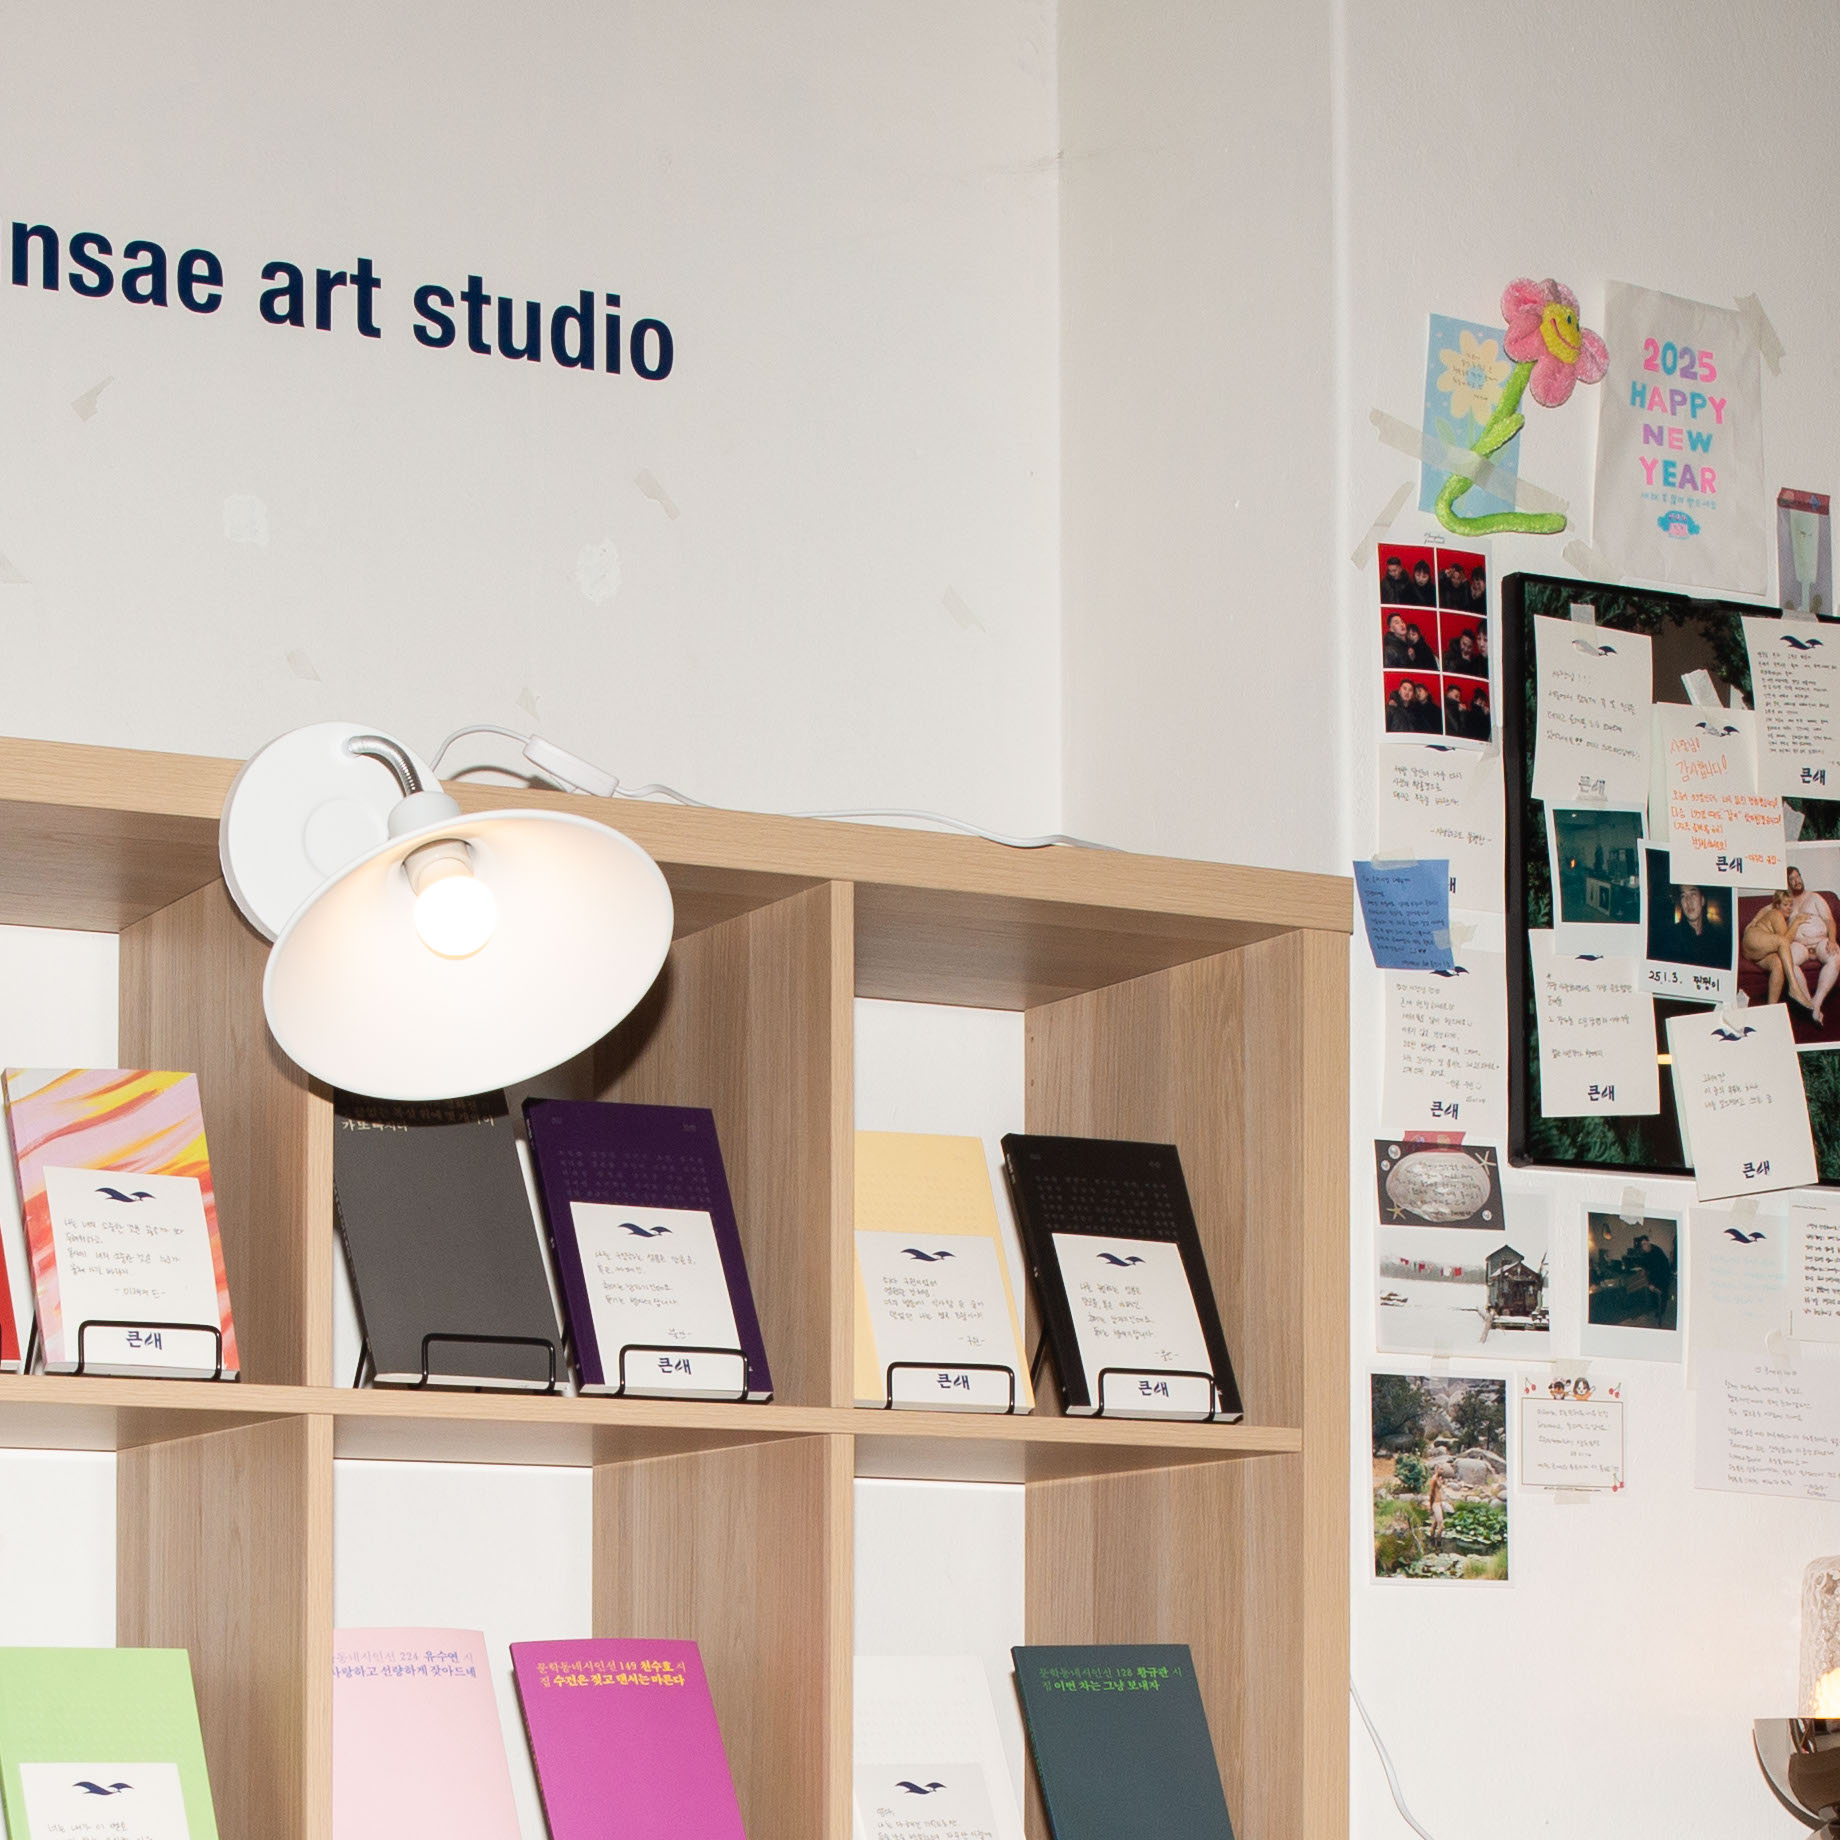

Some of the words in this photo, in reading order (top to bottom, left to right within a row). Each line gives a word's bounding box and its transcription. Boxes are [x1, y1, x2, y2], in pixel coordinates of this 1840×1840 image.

[259, 257, 381, 338] art
[413, 273, 674, 381] studio
[1643, 336, 1718, 383] 2025
[1629, 381, 1727, 425] HAPPY
[1641, 423, 1713, 455] NEW
[1638, 455, 1717, 495] YEAR
[1800, 767, 1826, 786] 큰새
[1716, 856, 1743, 873] 큰새
[1587, 1083, 1615, 1103] 큰새
[1430, 1100, 1459, 1120] 큰새
[1742, 1159, 1771, 1179] 큰새
[126, 1331, 163, 1350] 큰새
[658, 1358, 692, 1375] 큰새
[937, 1374, 971, 1391] 큰새
[1138, 1381, 1169, 1397] 큰새
[424, 1650, 459, 1663] 유수연
[382, 1664, 428, 1678] 선량하게
[431, 1666, 477, 1678] 잦아드네
[1054, 1680, 1077, 1692] 이번
[1079, 1680, 1101, 1692] 차는
[1103, 1679, 1124, 1692] 그냥
[1128, 1680, 1160, 1692] 보내자
